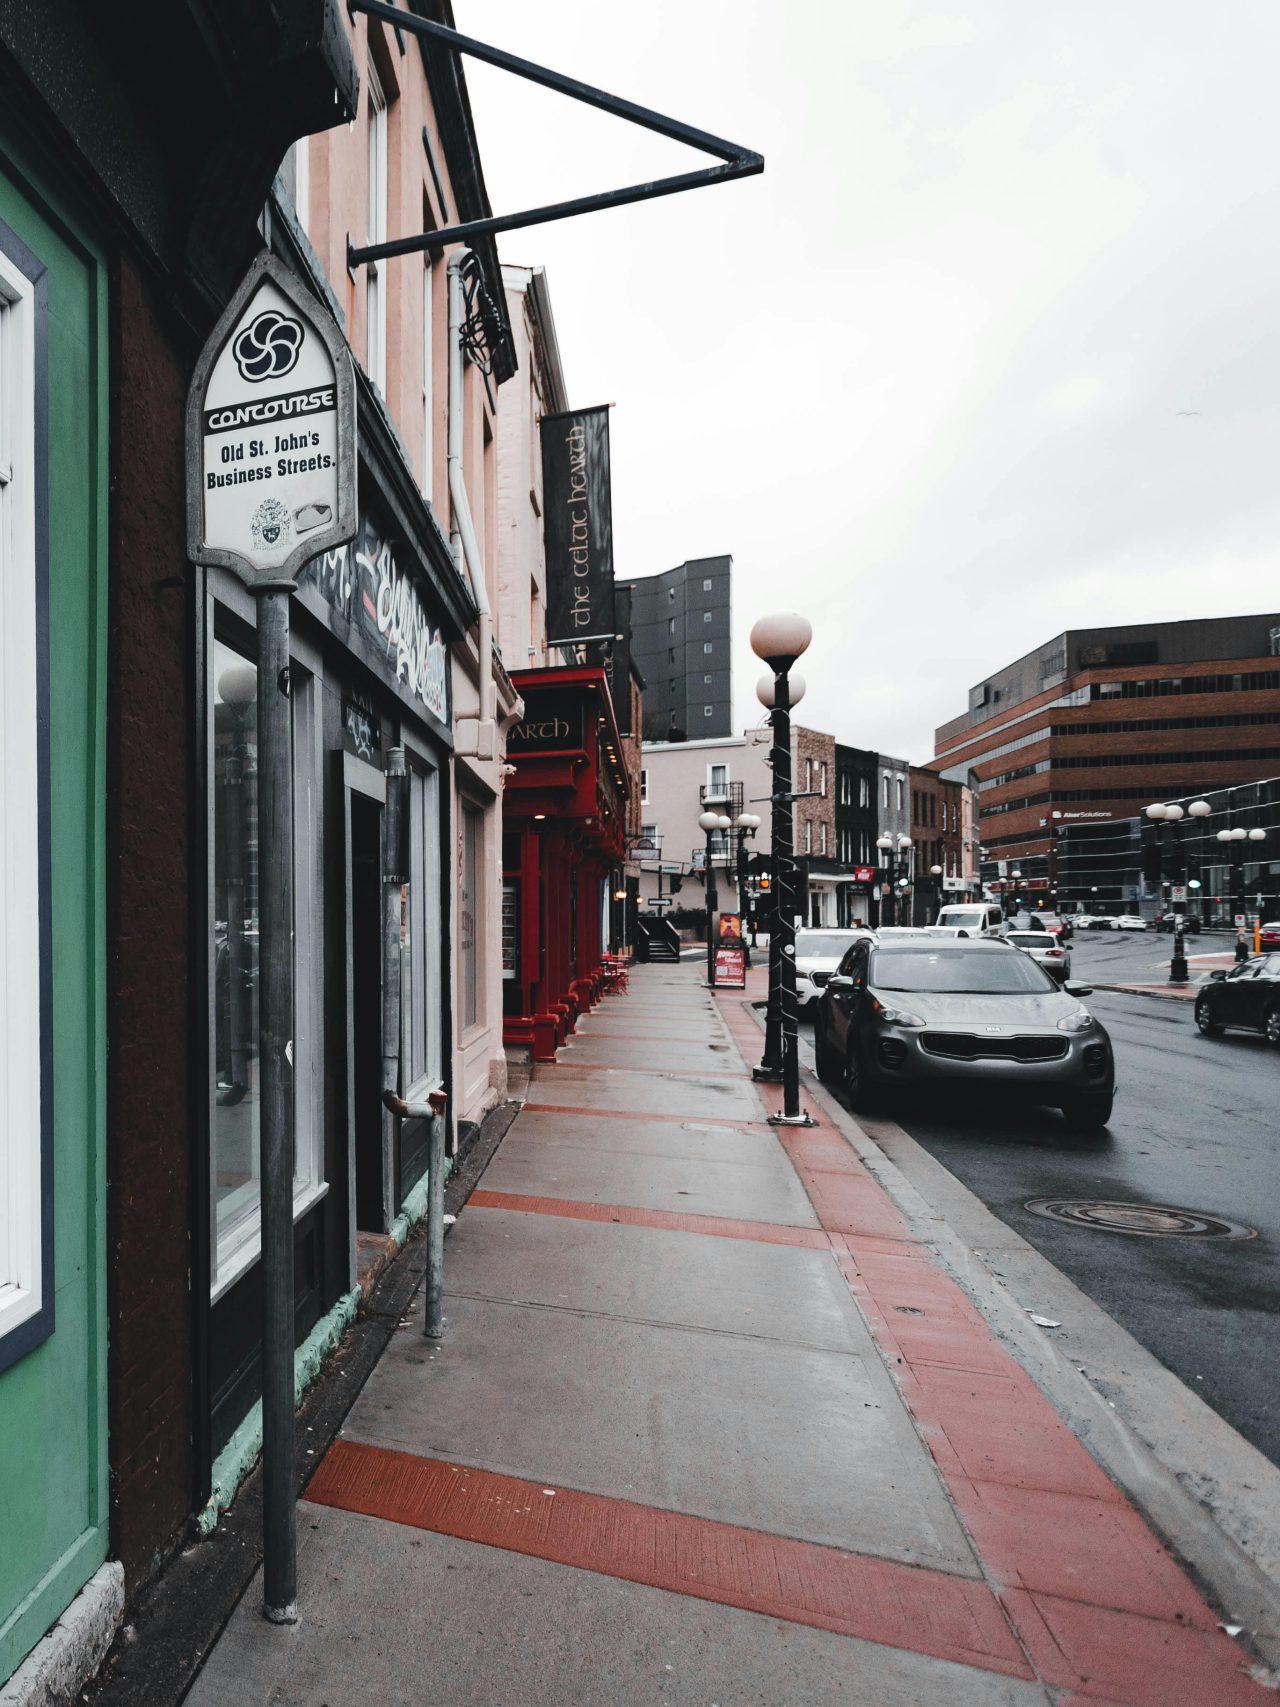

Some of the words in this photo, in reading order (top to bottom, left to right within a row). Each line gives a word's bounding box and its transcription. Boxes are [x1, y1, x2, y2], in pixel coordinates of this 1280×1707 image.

[208, 389, 334, 430] CONCOURSE
[221, 443, 244, 463] Old
[249, 440, 269, 458] St.
[274, 430, 320, 453] John's
[207, 468, 272, 489] Business
[277, 453, 336, 477] Streets.
